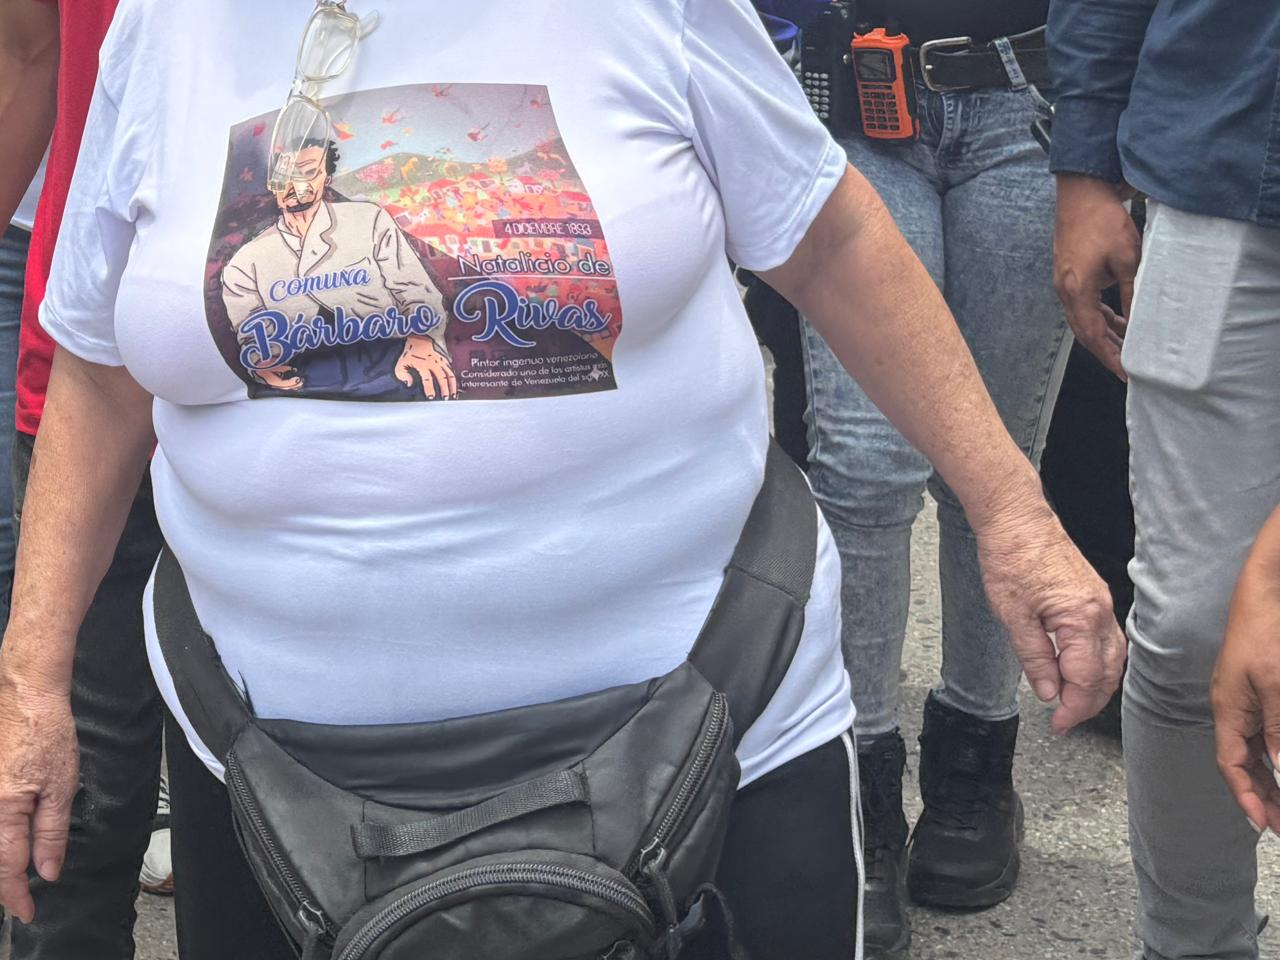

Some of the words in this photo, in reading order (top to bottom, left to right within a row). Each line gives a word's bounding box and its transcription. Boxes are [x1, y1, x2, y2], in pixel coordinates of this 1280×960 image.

[504, 223, 512, 235] 4
[566, 222, 592, 235] 1893
[457, 251, 571, 275] Natalicio
[577, 251, 611, 276] de
[453, 279, 613, 348] Rivas
[239, 304, 440, 370] Bárbaro
[471, 357, 501, 367] Pintor
[503, 356, 544, 368] ingenuo
[545, 351, 599, 364] venezolano
[460, 367, 518, 378] Considerado
[520, 368, 537, 376] uno
[538, 366, 550, 375] de
[551, 365, 563, 374] los
[461, 378, 509, 388] interesante
[511, 378, 523, 386] de
[524, 374, 566, 385] Venezuela
[567, 373, 580, 382] del
